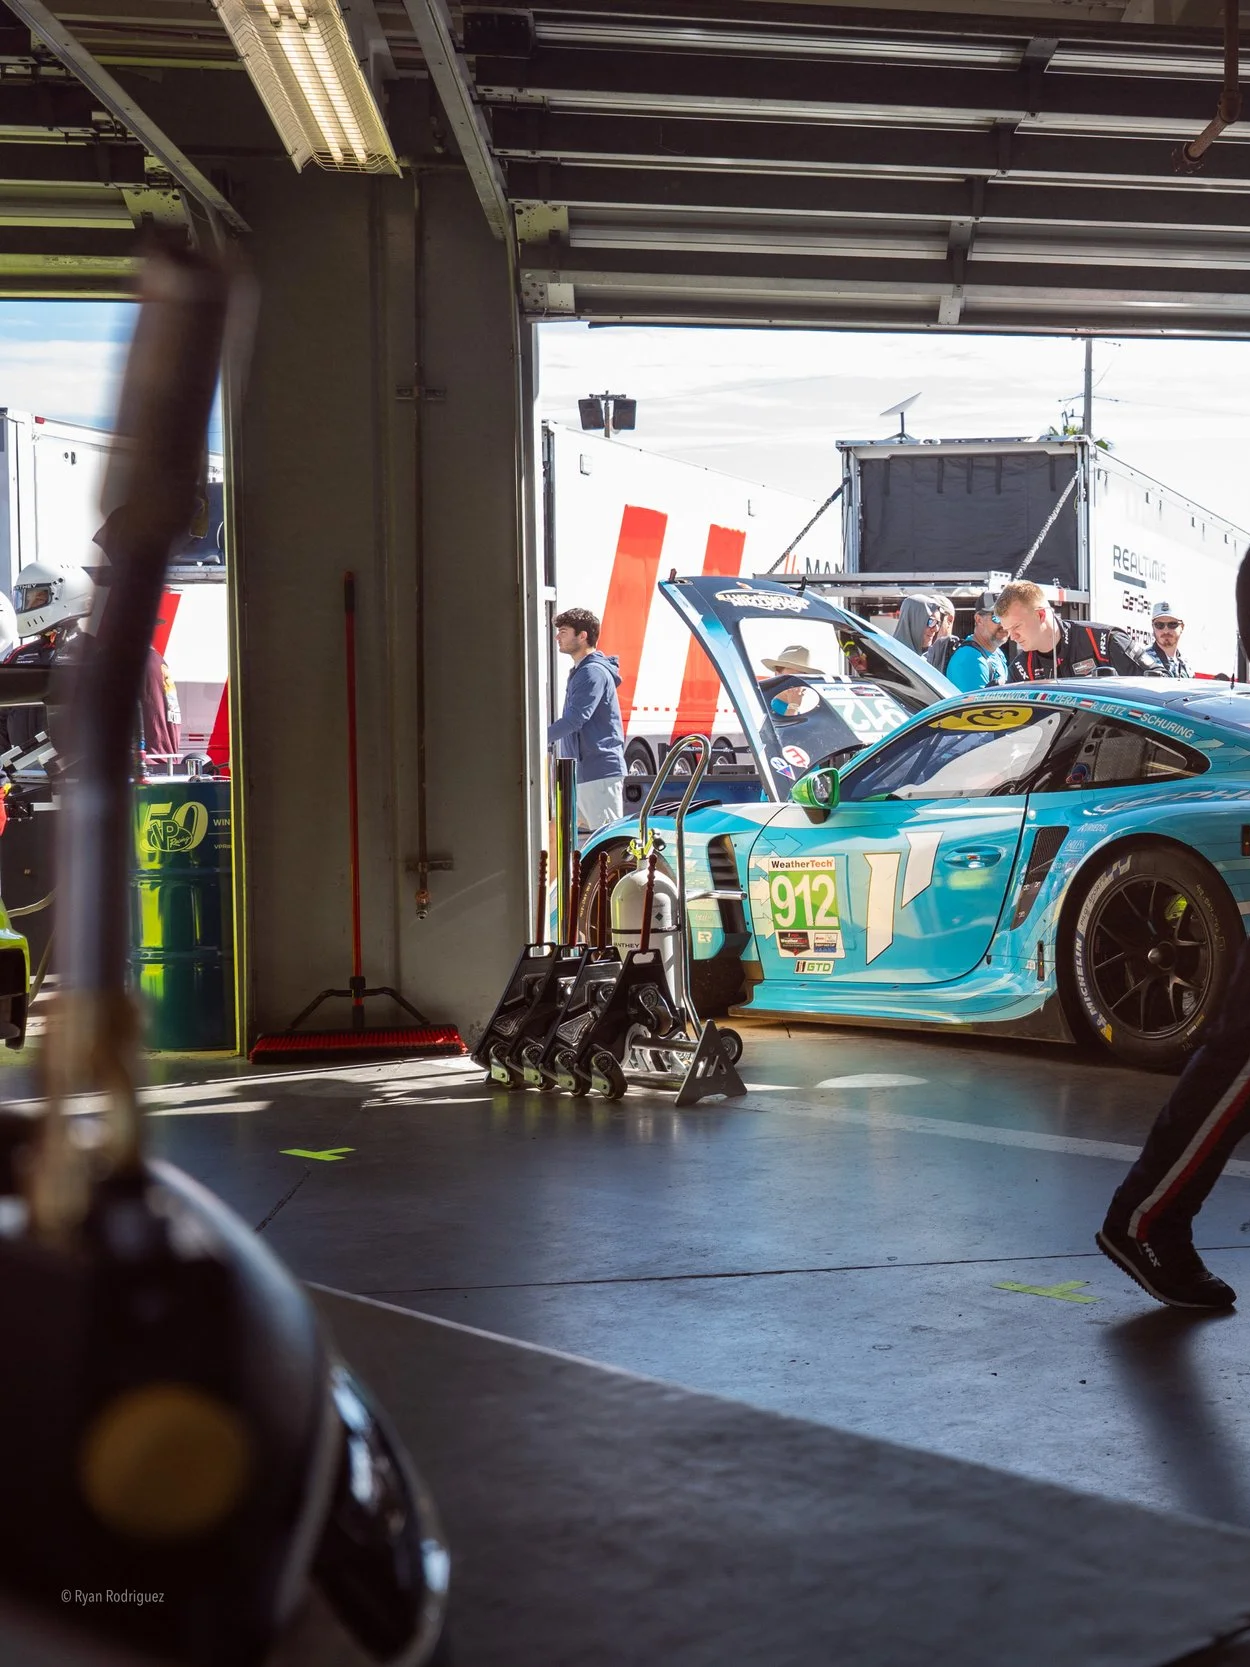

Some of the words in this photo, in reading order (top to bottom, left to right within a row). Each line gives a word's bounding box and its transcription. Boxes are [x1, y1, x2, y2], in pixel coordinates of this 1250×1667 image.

[1113, 544, 1167, 584] REALTIME
[1015, 661, 1029, 680] HRX
[1054, 694, 1078, 706] PERA
[1101, 702, 1127, 716] LIETZ
[1139, 712, 1195, 739] SCHURING
[771, 860, 834, 869] WeatherTech
[771, 874, 839, 927] 912
[807, 963, 831, 972] GTD
[1074, 938, 1097, 1016] MICHELIN
